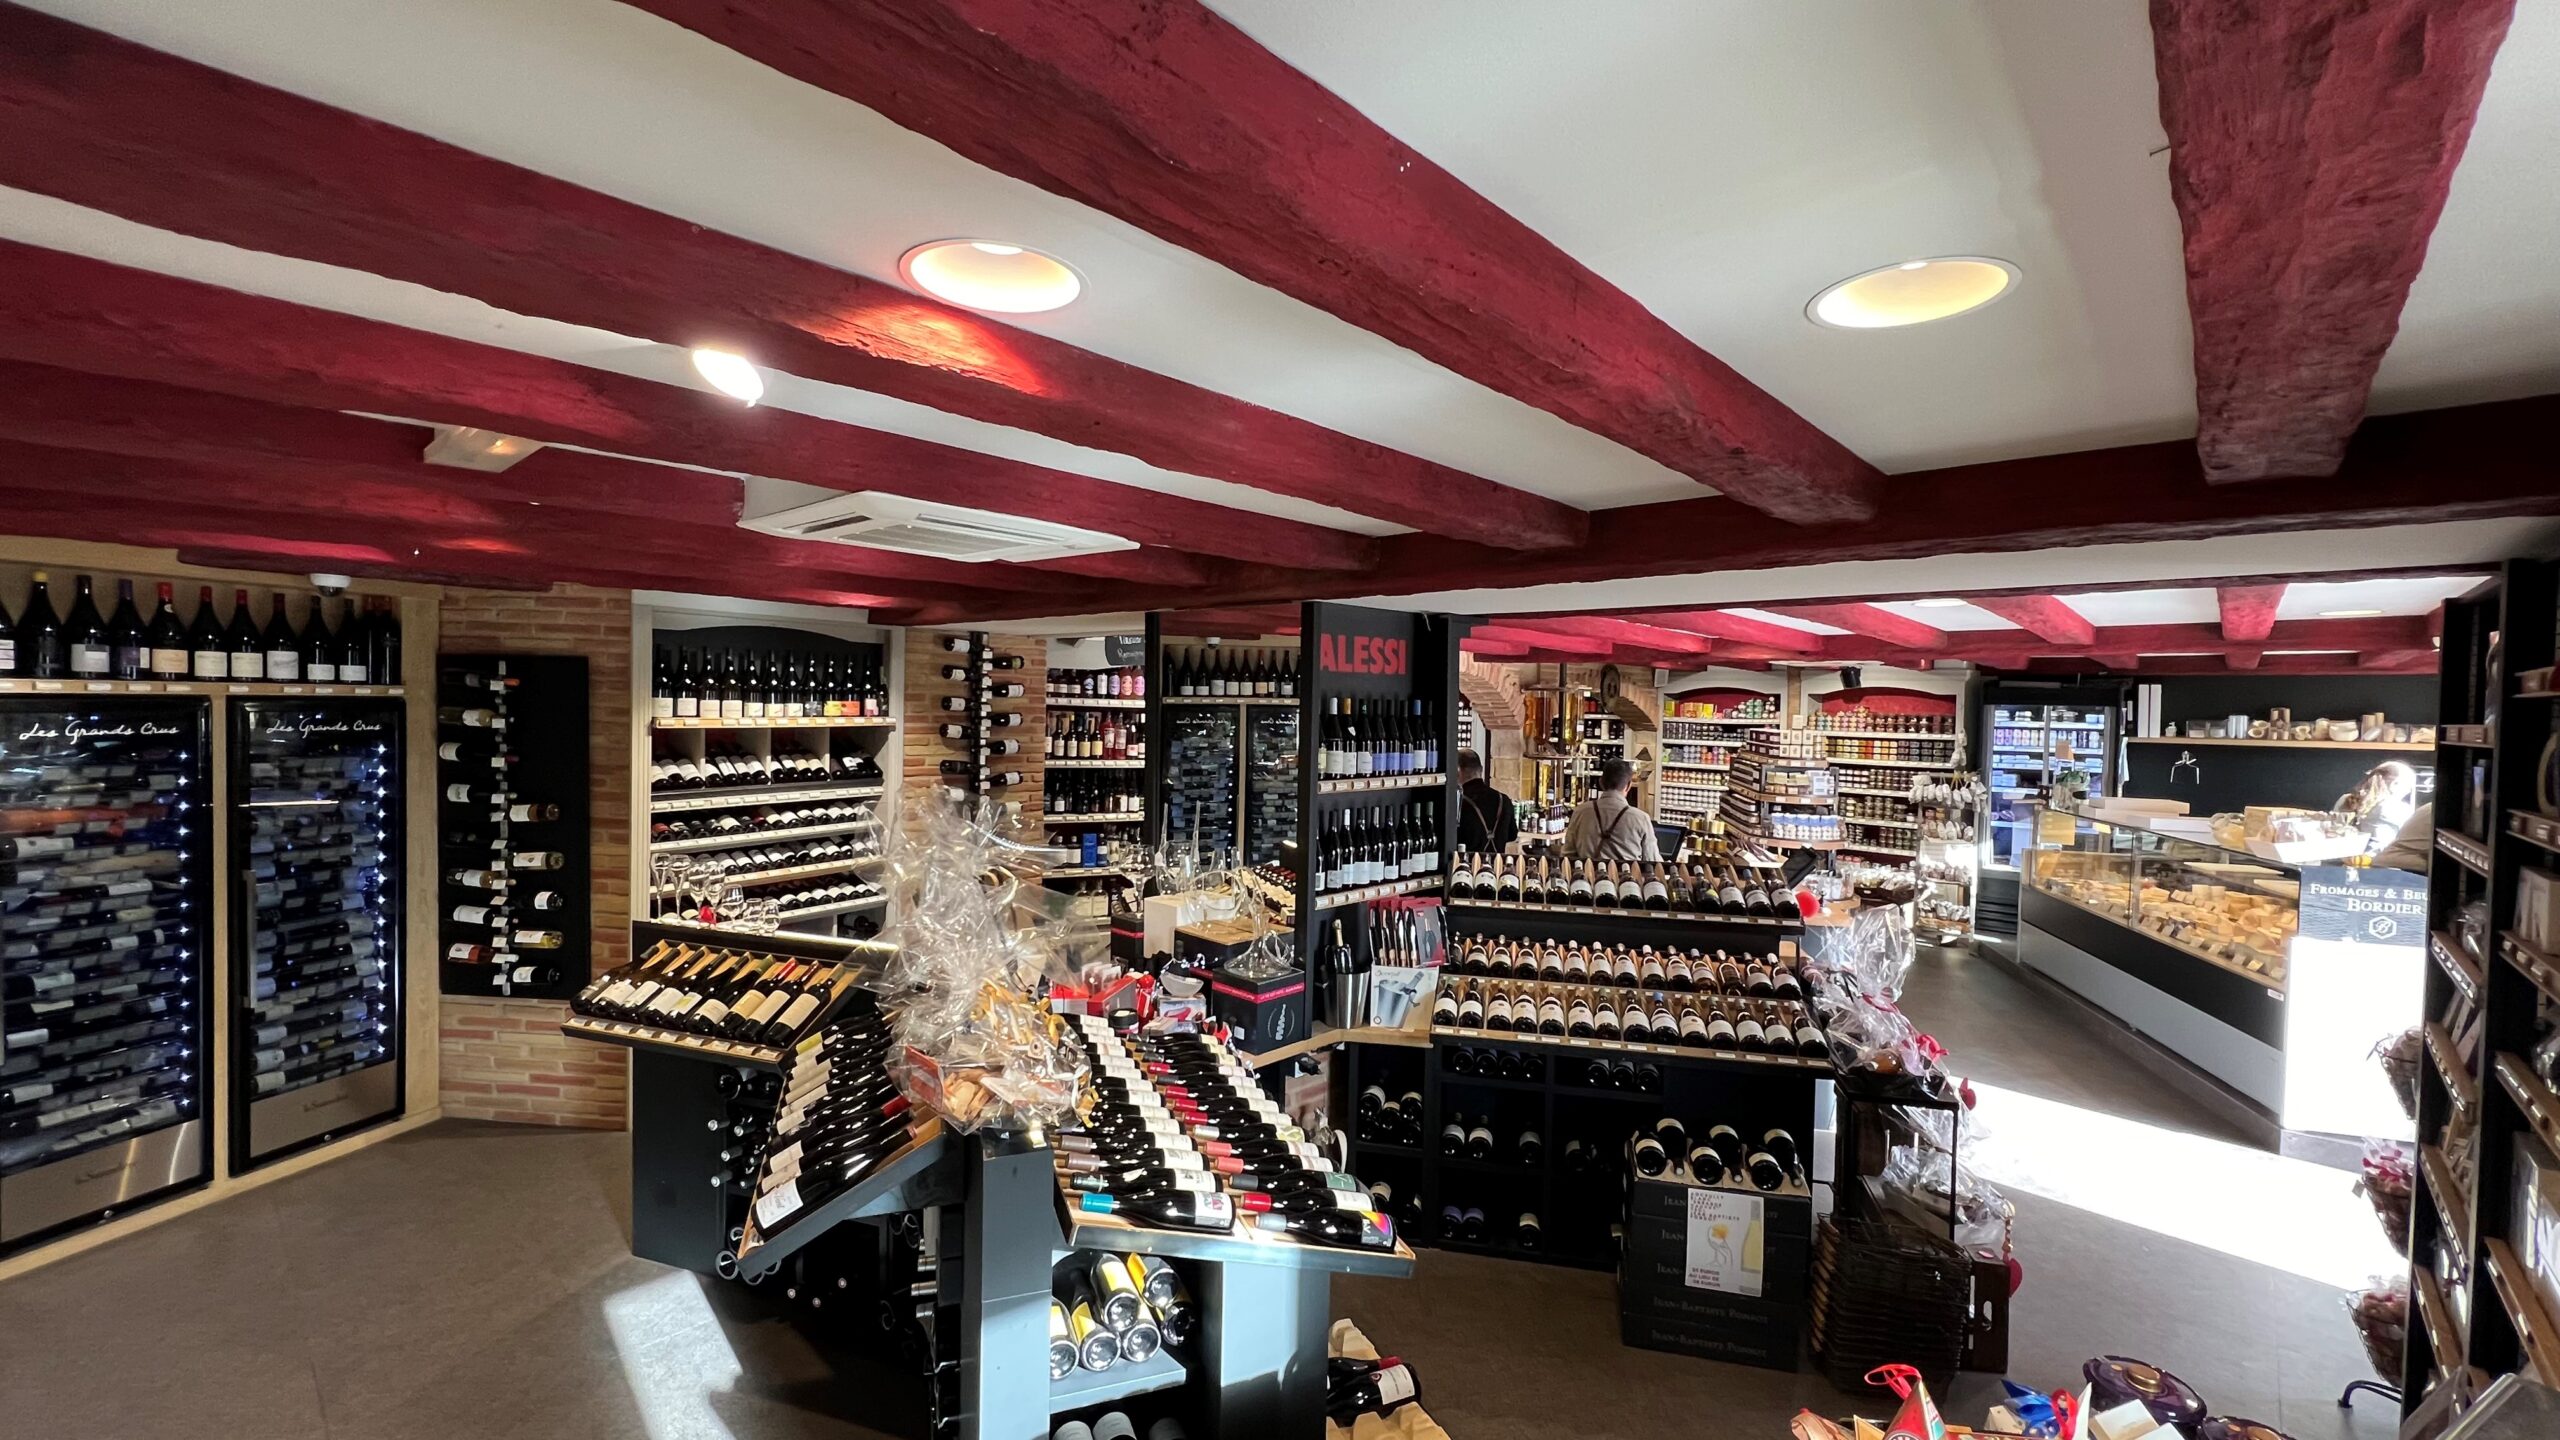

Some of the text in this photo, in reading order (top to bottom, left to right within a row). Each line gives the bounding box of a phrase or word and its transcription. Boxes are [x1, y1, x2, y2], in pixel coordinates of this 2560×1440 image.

[1320, 633, 1407, 675] ALESSI
[19, 720, 180, 745] Les Grands Crus
[266, 717, 382, 739] Les Grands Crus
[2310, 883, 2380, 898] FROMAGES
[2383, 888, 2398, 899] &
[2347, 897, 2424, 915] BORDIER
